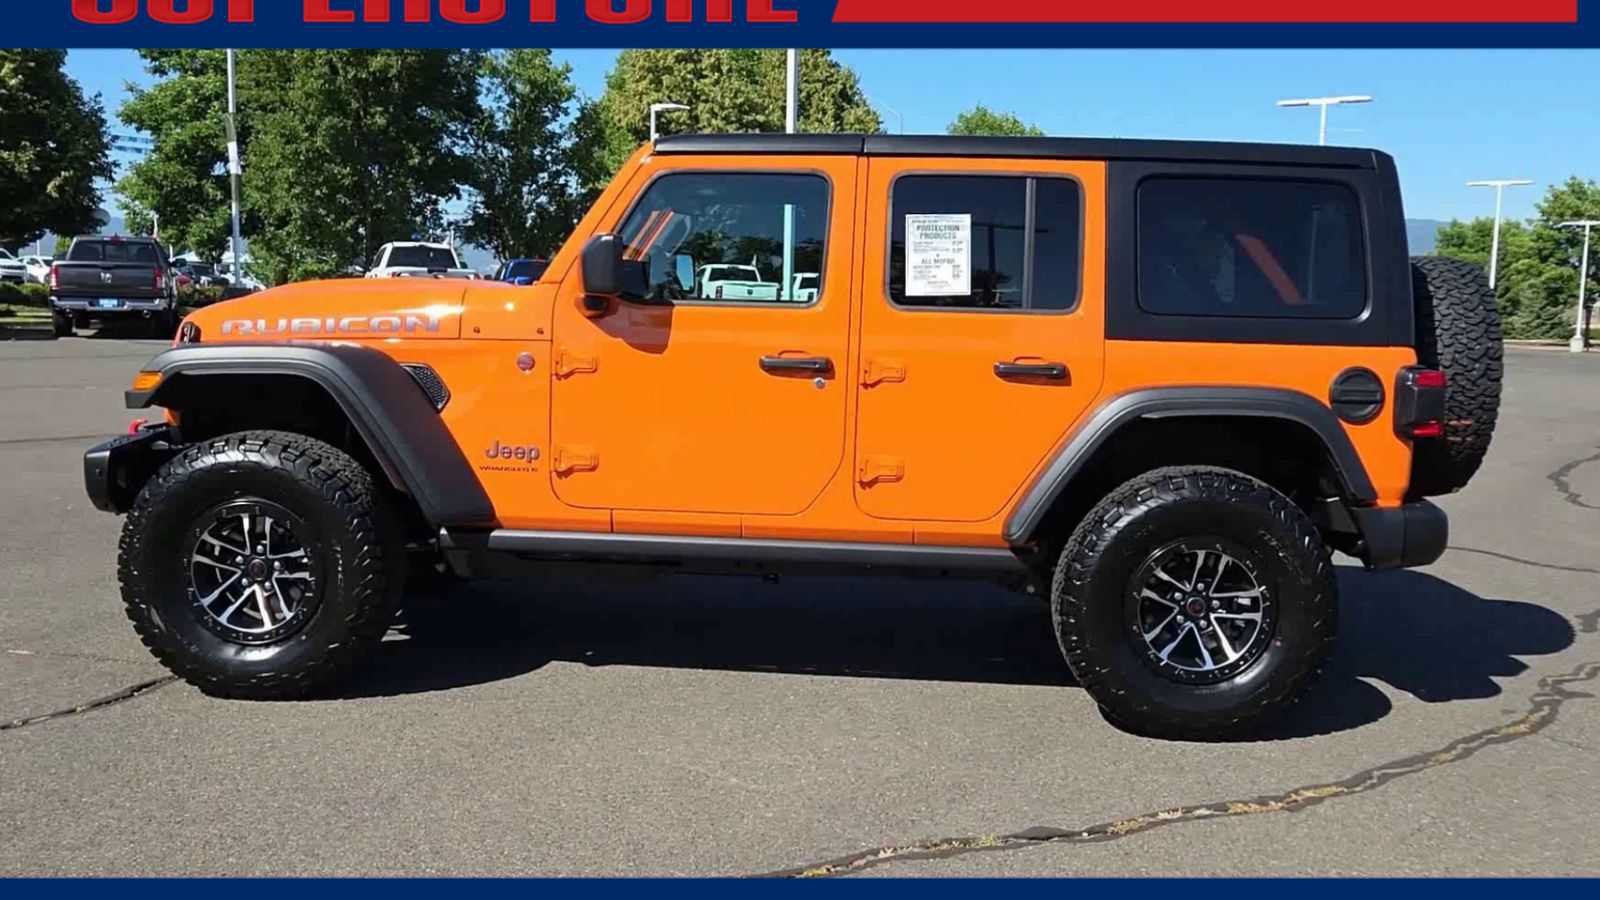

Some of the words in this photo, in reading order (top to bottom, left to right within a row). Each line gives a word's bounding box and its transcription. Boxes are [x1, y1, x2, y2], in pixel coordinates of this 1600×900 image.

[919, 232, 957, 240] PRODUCTS
[221, 315, 441, 335] RUBICON
[486, 440, 540, 463] Jeep
